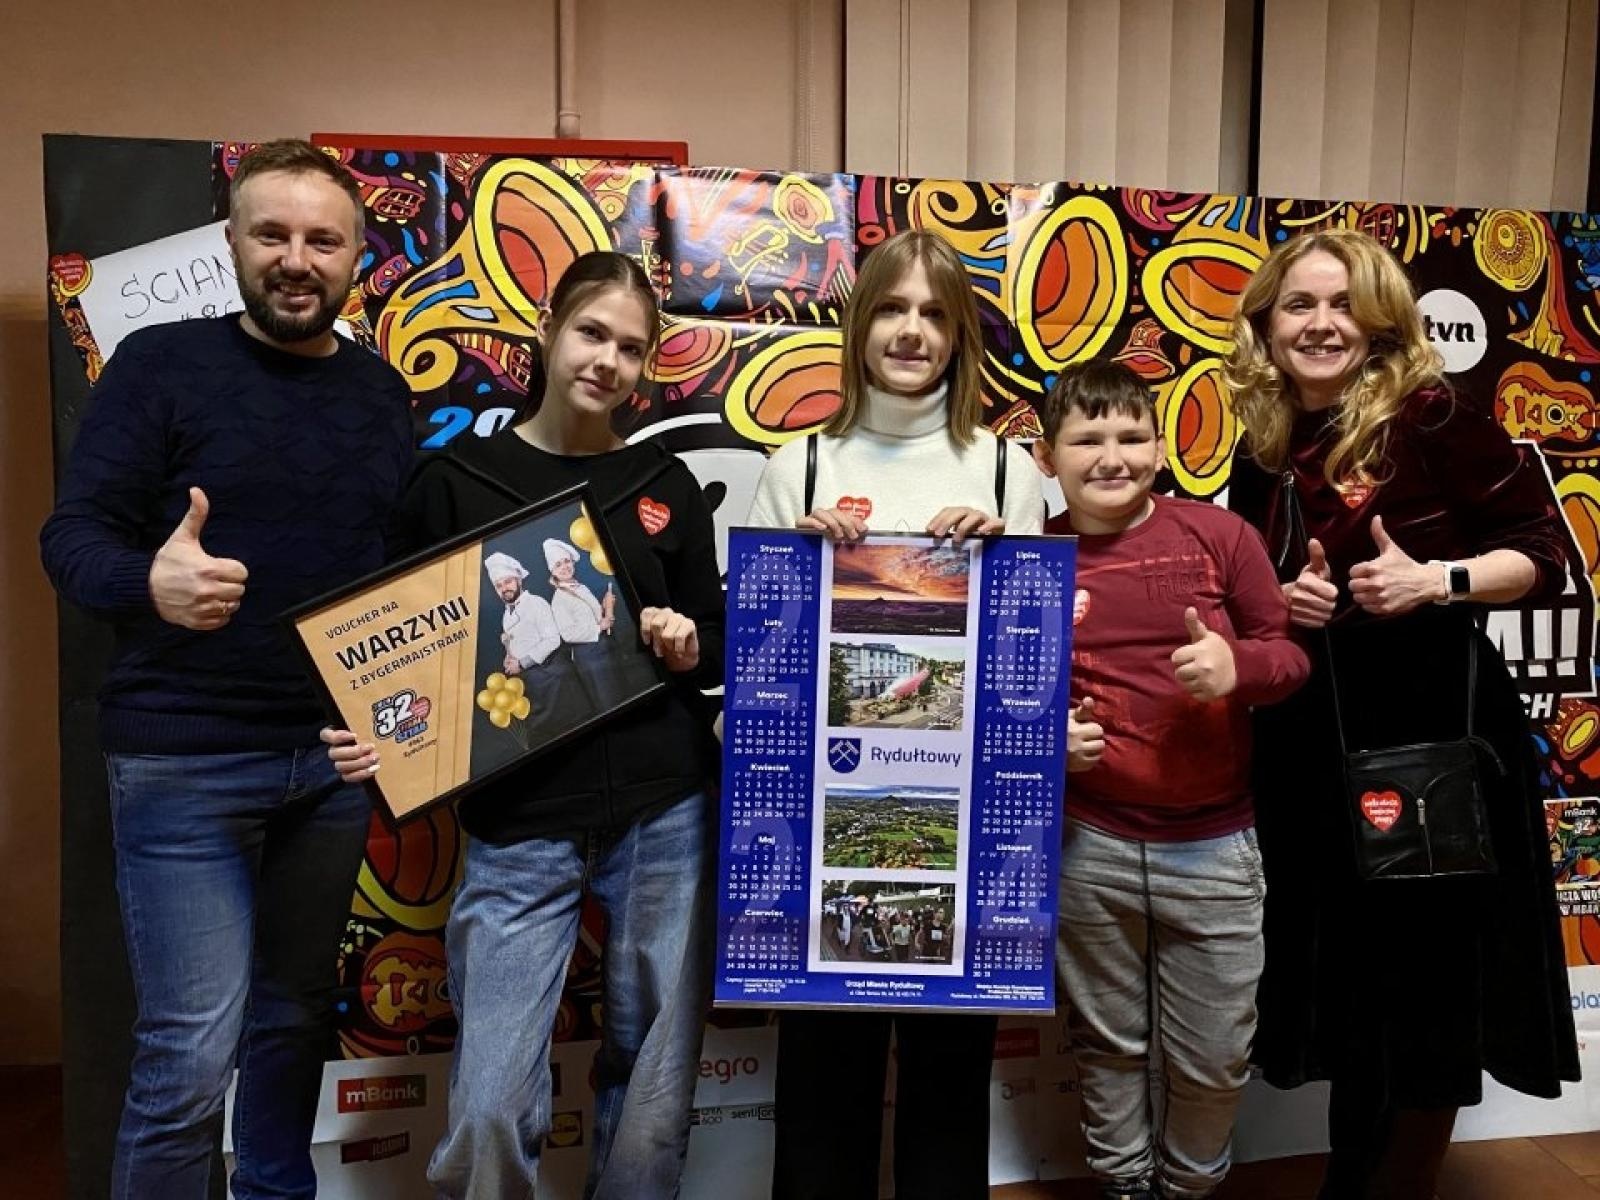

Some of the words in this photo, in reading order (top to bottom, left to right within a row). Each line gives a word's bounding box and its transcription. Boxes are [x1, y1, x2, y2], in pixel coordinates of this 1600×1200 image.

[1424, 314, 1476, 343] tvn
[1016, 551, 1041, 560] Lipiec
[325, 608, 381, 640] VOUCHER
[382, 600, 400, 615] NA
[764, 619, 783, 627] Luty
[334, 596, 471, 671] WARZYNI
[349, 679, 359, 691] Z
[756, 691, 788, 699] Marzec
[376, 692, 414, 736] 32
[871, 746, 962, 768] Rydułtowy
[758, 835, 775, 844] Maj
[345, 1083, 419, 1105] mBank
